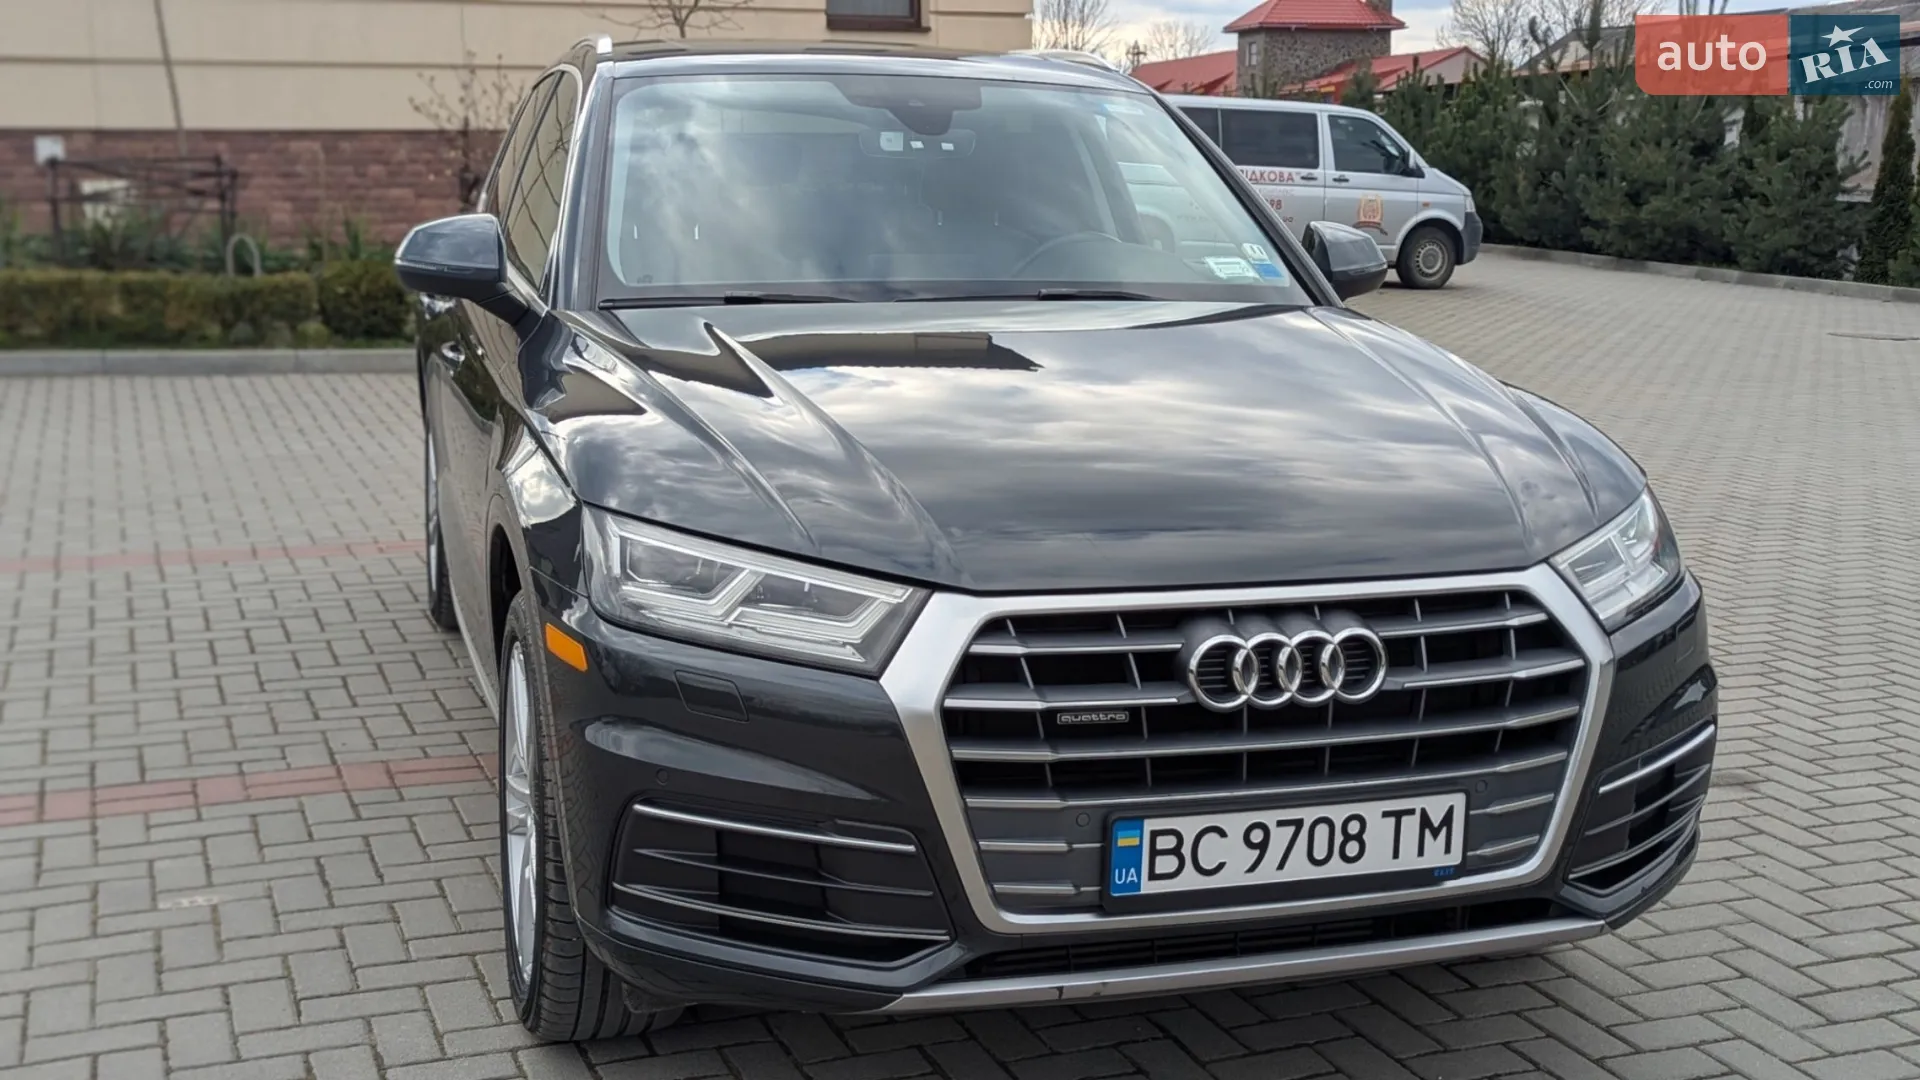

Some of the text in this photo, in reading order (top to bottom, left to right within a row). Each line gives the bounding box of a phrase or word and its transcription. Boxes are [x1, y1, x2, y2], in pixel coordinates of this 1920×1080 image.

[1060, 713, 1126, 723] quattro
[1147, 804, 1456, 882] BC 9708 TM
[1114, 867, 1138, 885] UA
